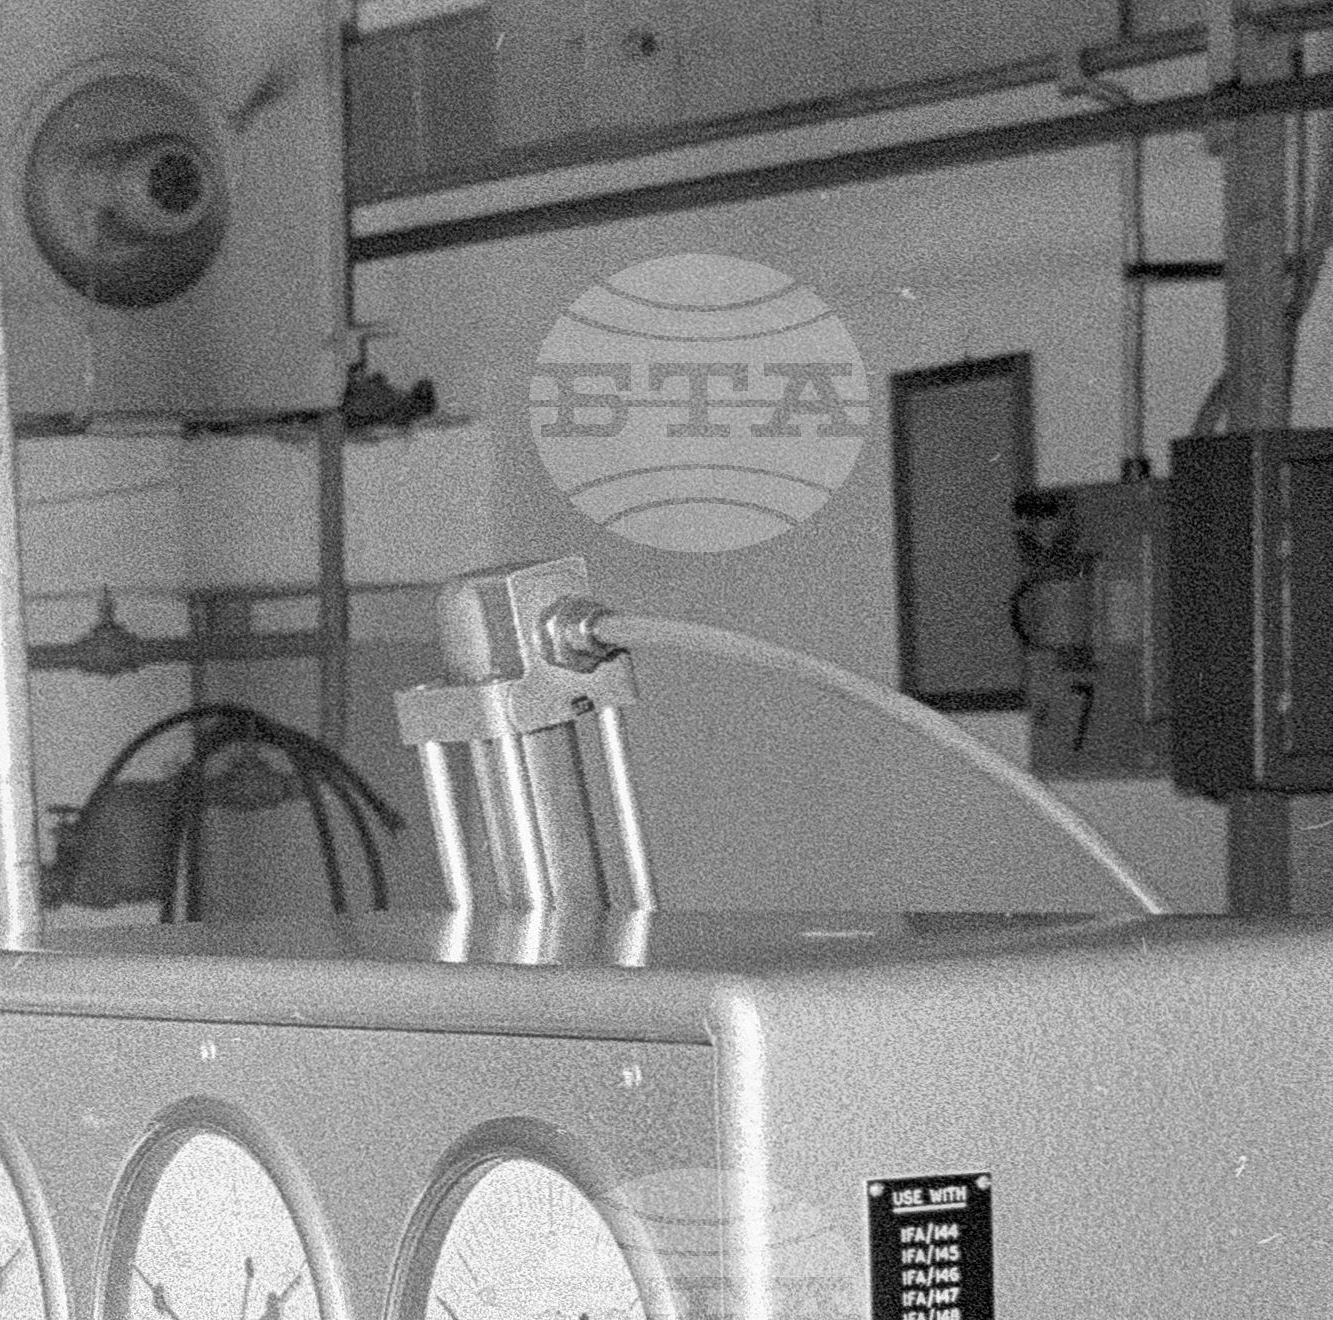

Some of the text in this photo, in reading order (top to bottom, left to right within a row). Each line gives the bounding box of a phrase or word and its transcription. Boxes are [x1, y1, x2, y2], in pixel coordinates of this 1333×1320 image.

[892, 1185, 968, 1206] USE WITH
[900, 1223, 959, 1244] IFA/144
[901, 1244, 961, 1264] IFA/145
[901, 1265, 961, 1287] IFA/146
[902, 1286, 961, 1308] IFA/147
